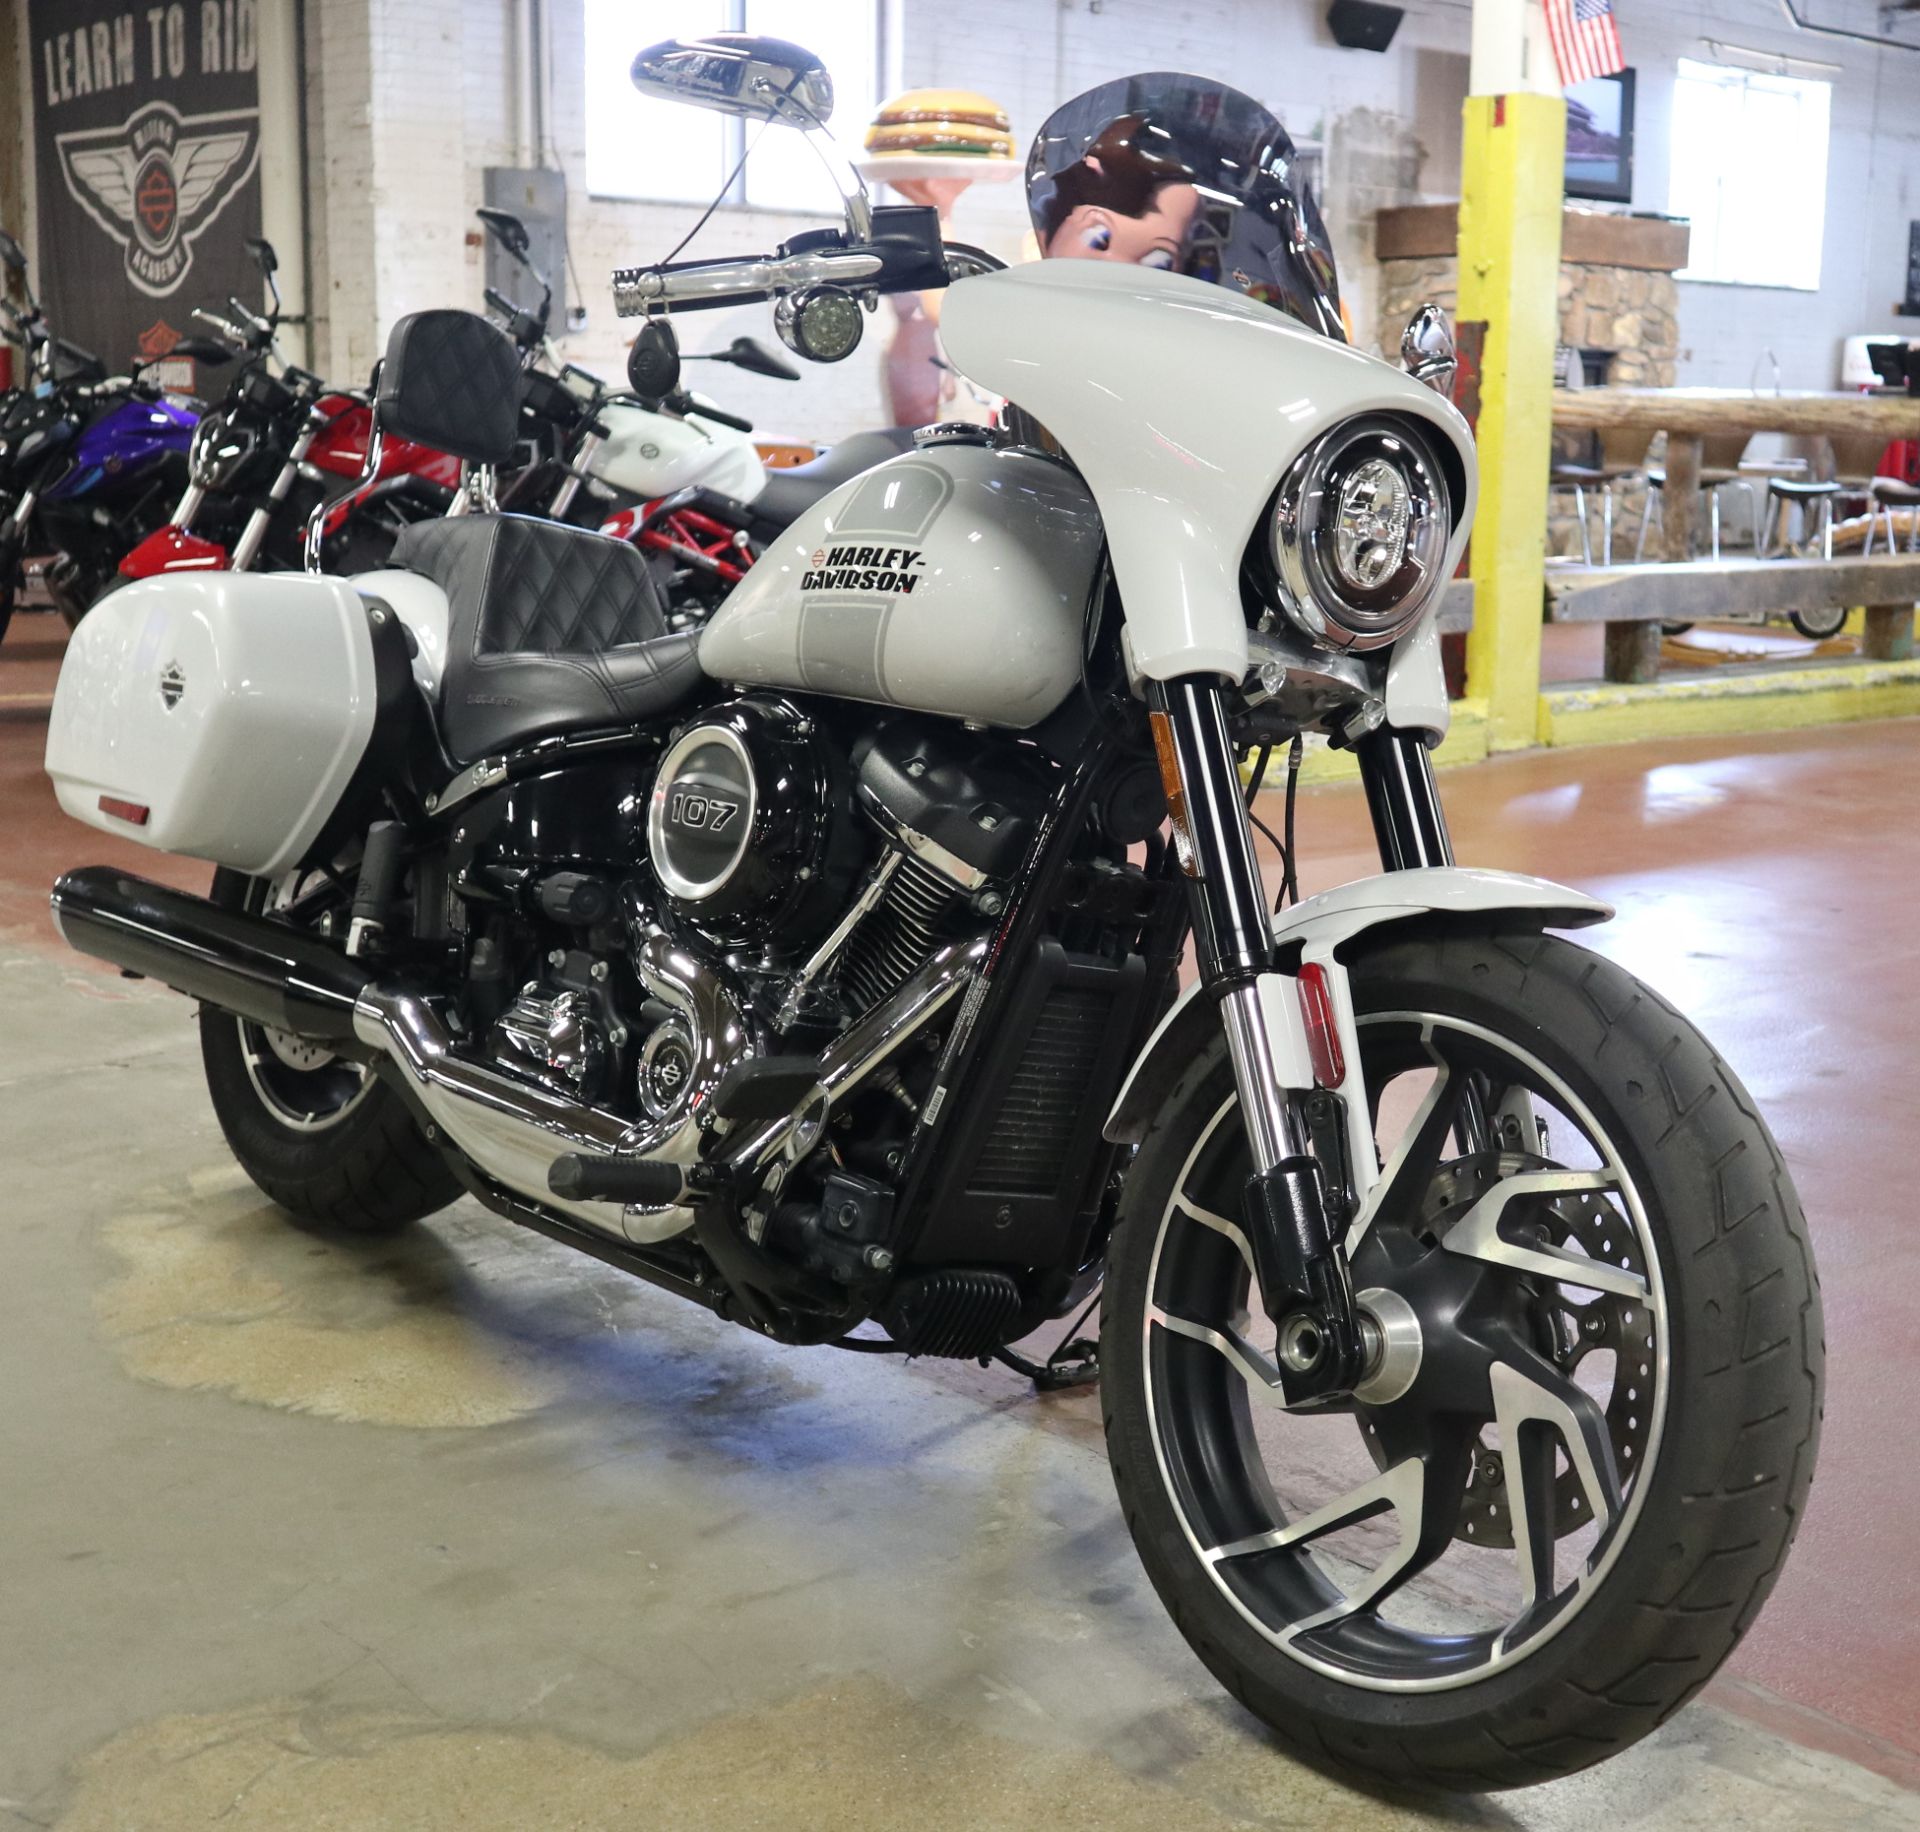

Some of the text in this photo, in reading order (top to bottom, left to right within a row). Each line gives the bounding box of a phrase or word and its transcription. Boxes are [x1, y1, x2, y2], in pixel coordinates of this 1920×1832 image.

[44, 14, 135, 106] LEARN
[147, 3, 186, 80] TO
[131, 244, 184, 283] ACADEMY
[826, 547, 926, 569] HARLEY-
[800, 570, 918, 593] DAVIDSON
[672, 793, 738, 831] 107
